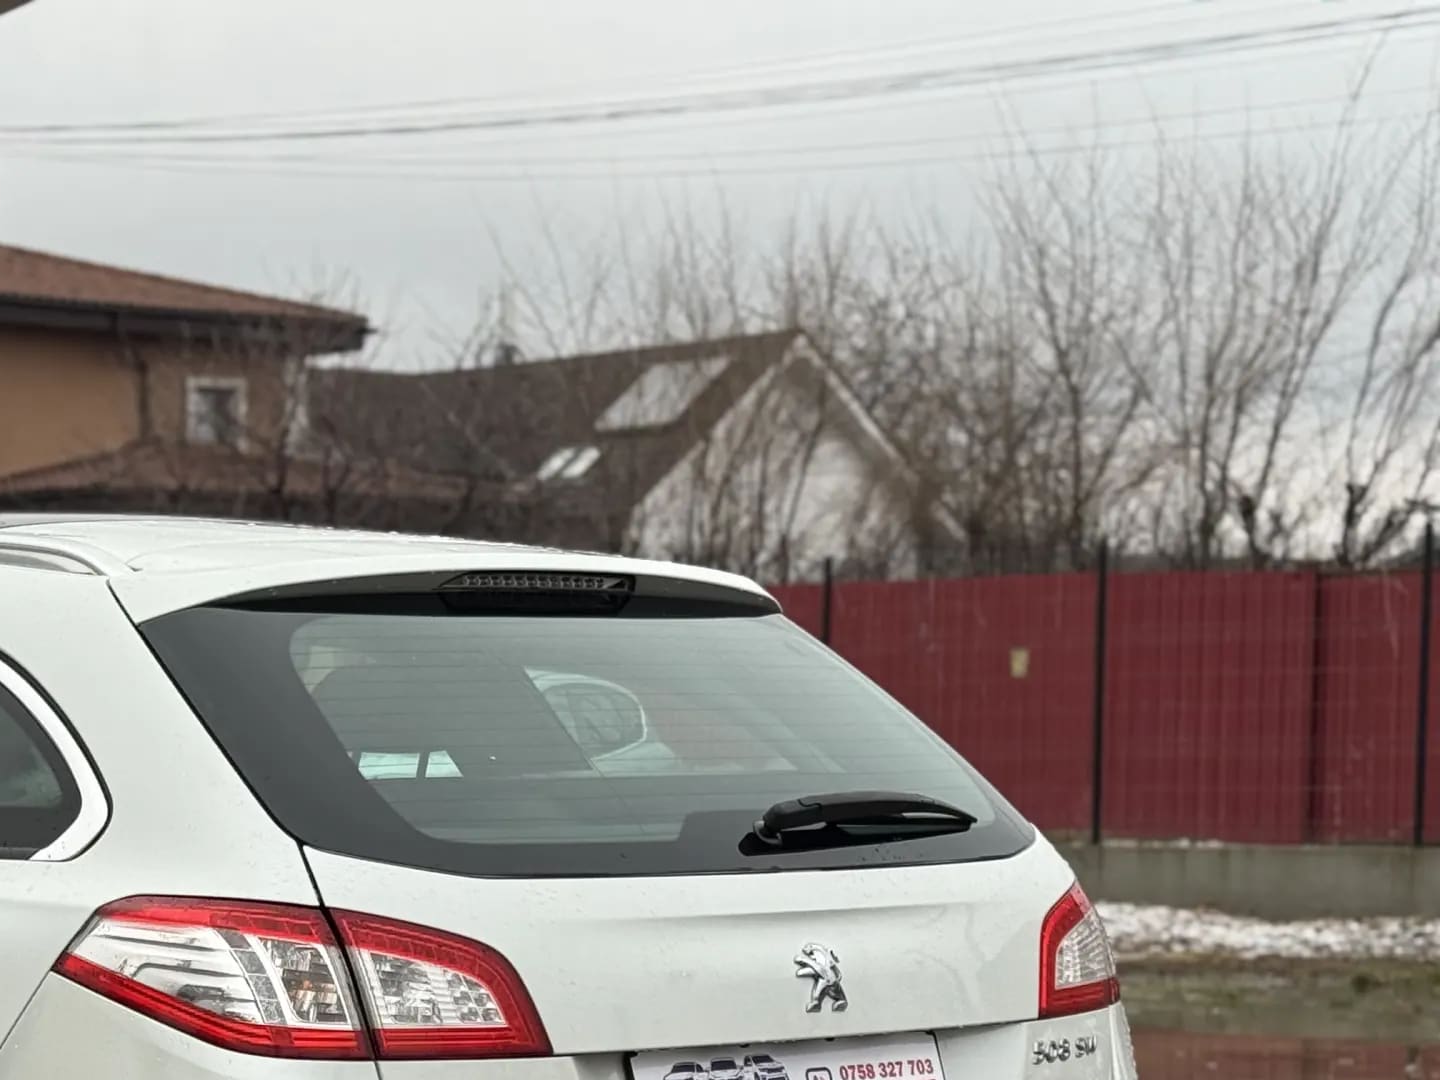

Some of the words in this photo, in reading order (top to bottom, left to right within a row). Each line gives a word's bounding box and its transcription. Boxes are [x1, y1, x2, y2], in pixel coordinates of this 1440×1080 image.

[1032, 1038, 1071, 1066] 508
[840, 1064, 875, 1080] 0758
[878, 1061, 903, 1078] 327
[907, 1058, 934, 1076] 703
